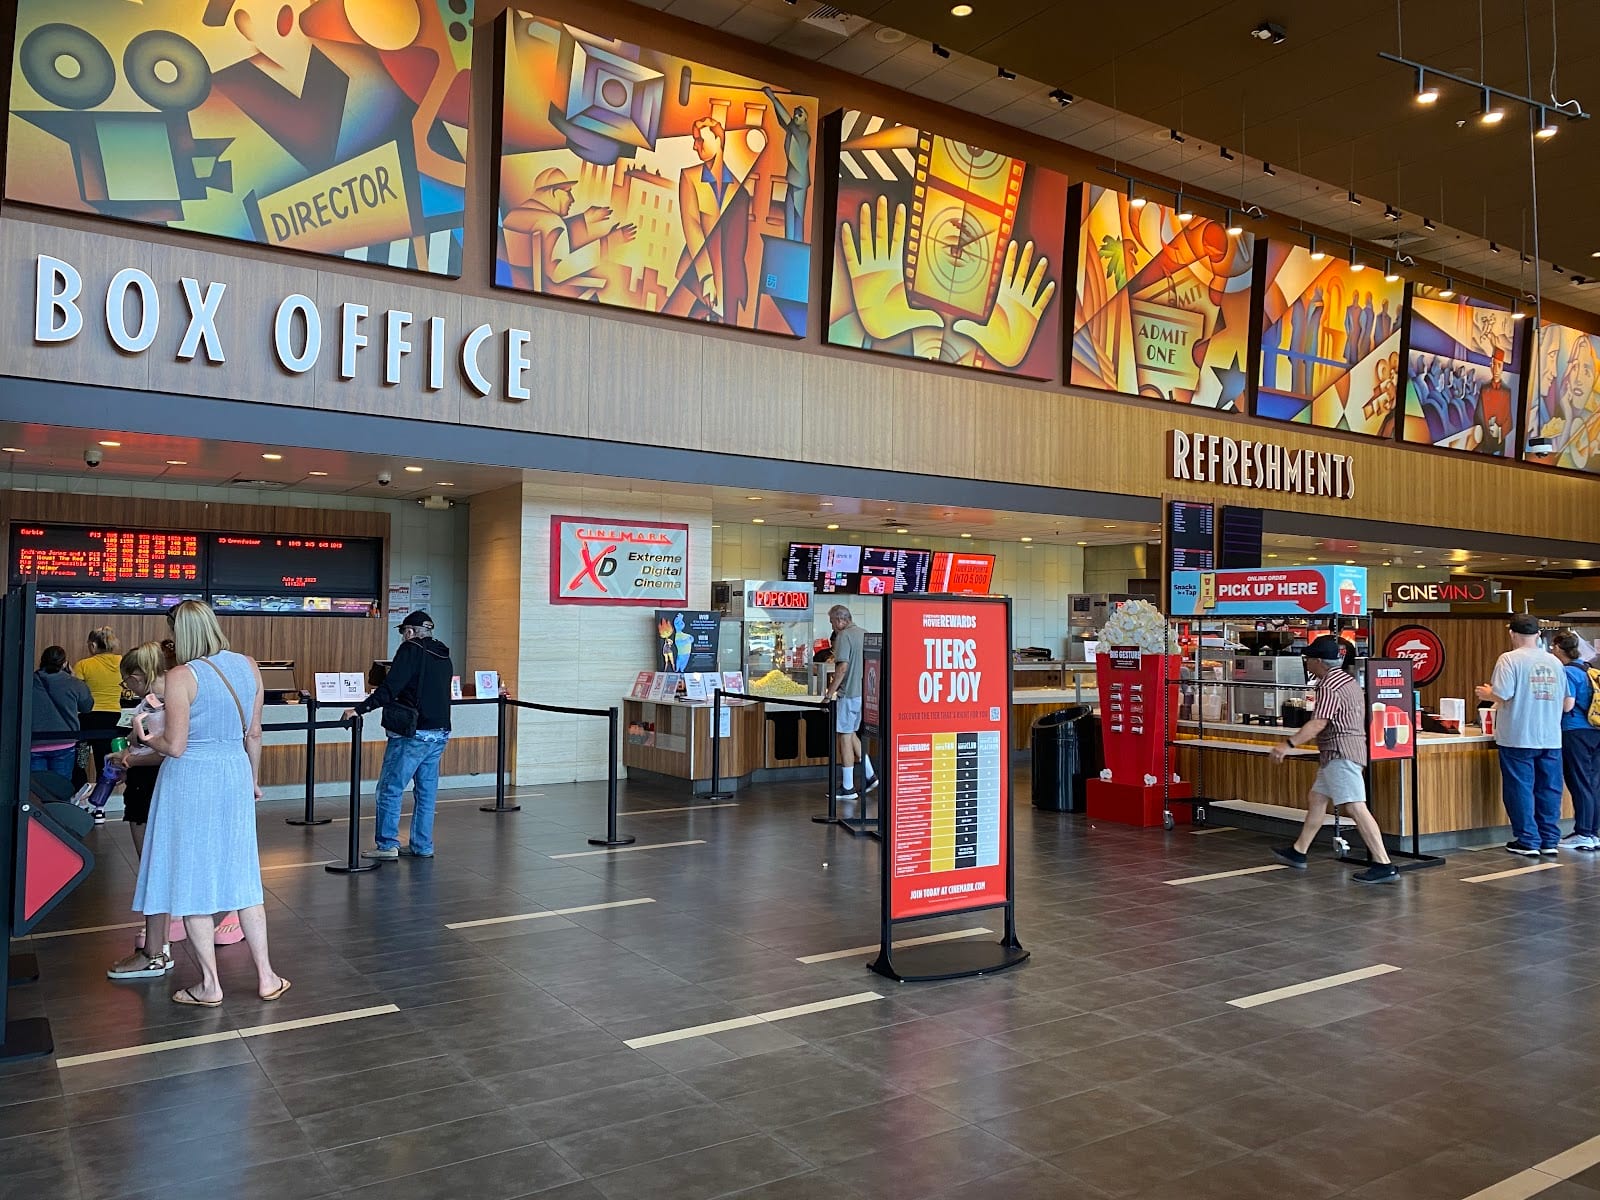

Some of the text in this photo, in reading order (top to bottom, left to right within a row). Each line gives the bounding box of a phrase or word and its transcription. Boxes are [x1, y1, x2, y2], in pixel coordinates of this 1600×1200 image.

[269, 165, 398, 243] DIRECTOR
[35, 254, 531, 400] BOX OFFICE
[1138, 322, 1189, 347] ADMIT
[1146, 344, 1177, 365] ONE
[1170, 429, 1355, 500] REFRESHMENTS
[576, 528, 670, 544] CINEMARK
[568, 541, 618, 593] XD
[628, 552, 682, 564] Extreme
[641, 565, 682, 577] Digital
[634, 578, 682, 589] Cinema
[1219, 582, 1318, 596] PICK UP HERE
[756, 591, 808, 608] POPCORN
[924, 638, 977, 670] TIERS
[1398, 650, 1428, 662] Pizza
[918, 672, 982, 704] OF JOY
[910, 889, 923, 900] JOIN
[924, 887, 940, 898] TODAY
[941, 886, 948, 895] AT
[948, 881, 986, 894] CINEMARK.COM
